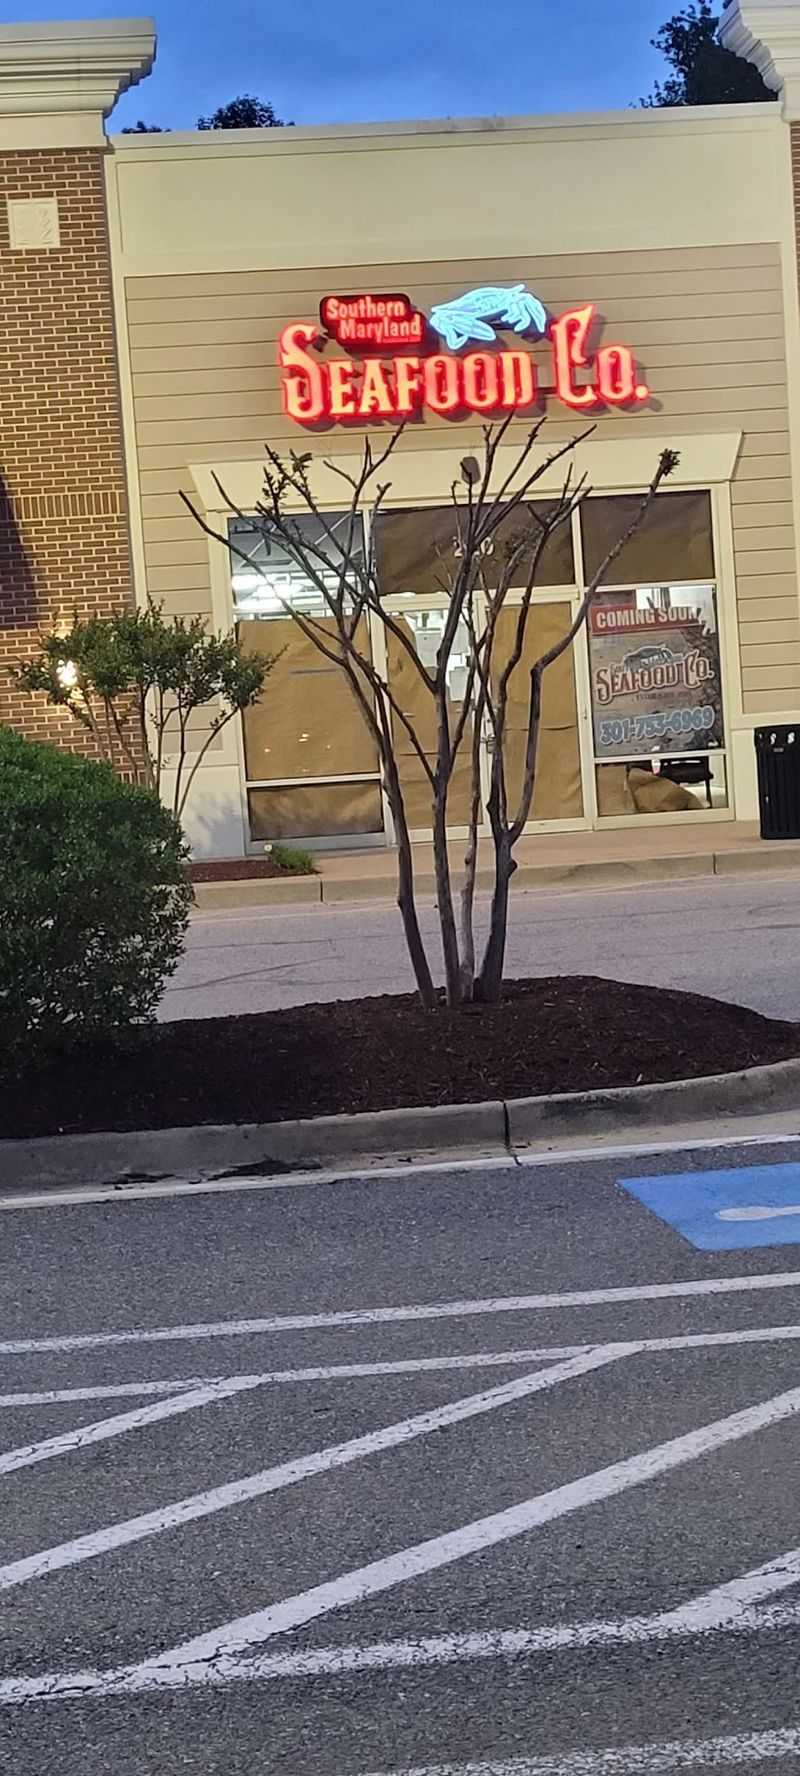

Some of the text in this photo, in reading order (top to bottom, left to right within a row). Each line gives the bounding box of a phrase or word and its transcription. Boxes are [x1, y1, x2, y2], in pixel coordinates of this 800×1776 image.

[326, 295, 405, 319] Southern
[338, 313, 421, 343] Maryland
[279, 322, 536, 423] SEAFOOD
[453, 536, 494, 557] 20
[596, 608, 656, 629] COMING
[596, 662, 679, 704] SEAFOOD
[599, 704, 715, 745] 301-753-6969
